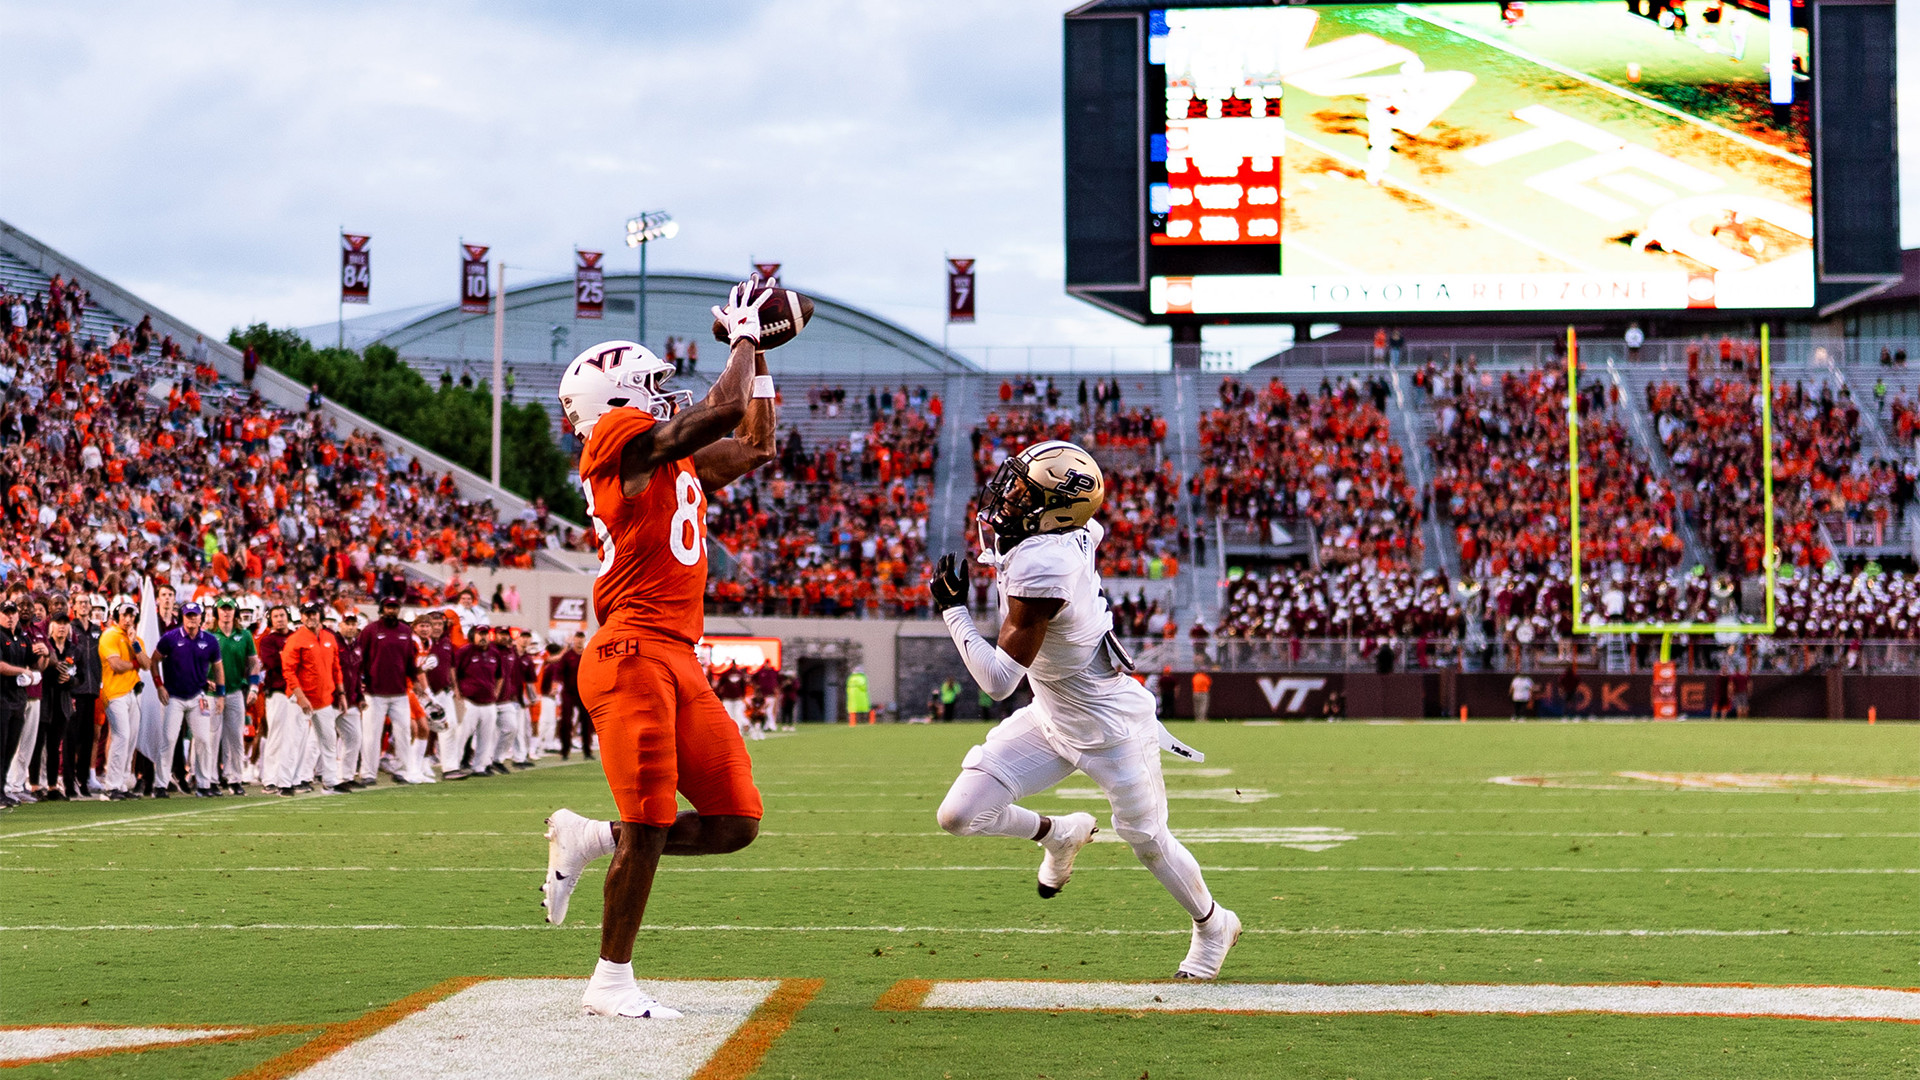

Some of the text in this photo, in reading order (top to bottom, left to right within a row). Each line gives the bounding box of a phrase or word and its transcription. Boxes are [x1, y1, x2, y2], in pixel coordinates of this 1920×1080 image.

[344, 265, 368, 288] 84
[467, 275, 486, 297] 10
[580, 281, 603, 303] 25
[955, 288, 969, 309] 7
[1308, 282, 1648, 300] TOYOTA RED ZONE
[584, 346, 633, 373] VT
[1054, 468, 1096, 497] P
[670, 471, 708, 566] 8
[553, 599, 585, 619] ACC
[596, 639, 639, 660] TECH
[1257, 677, 1327, 712] VT
